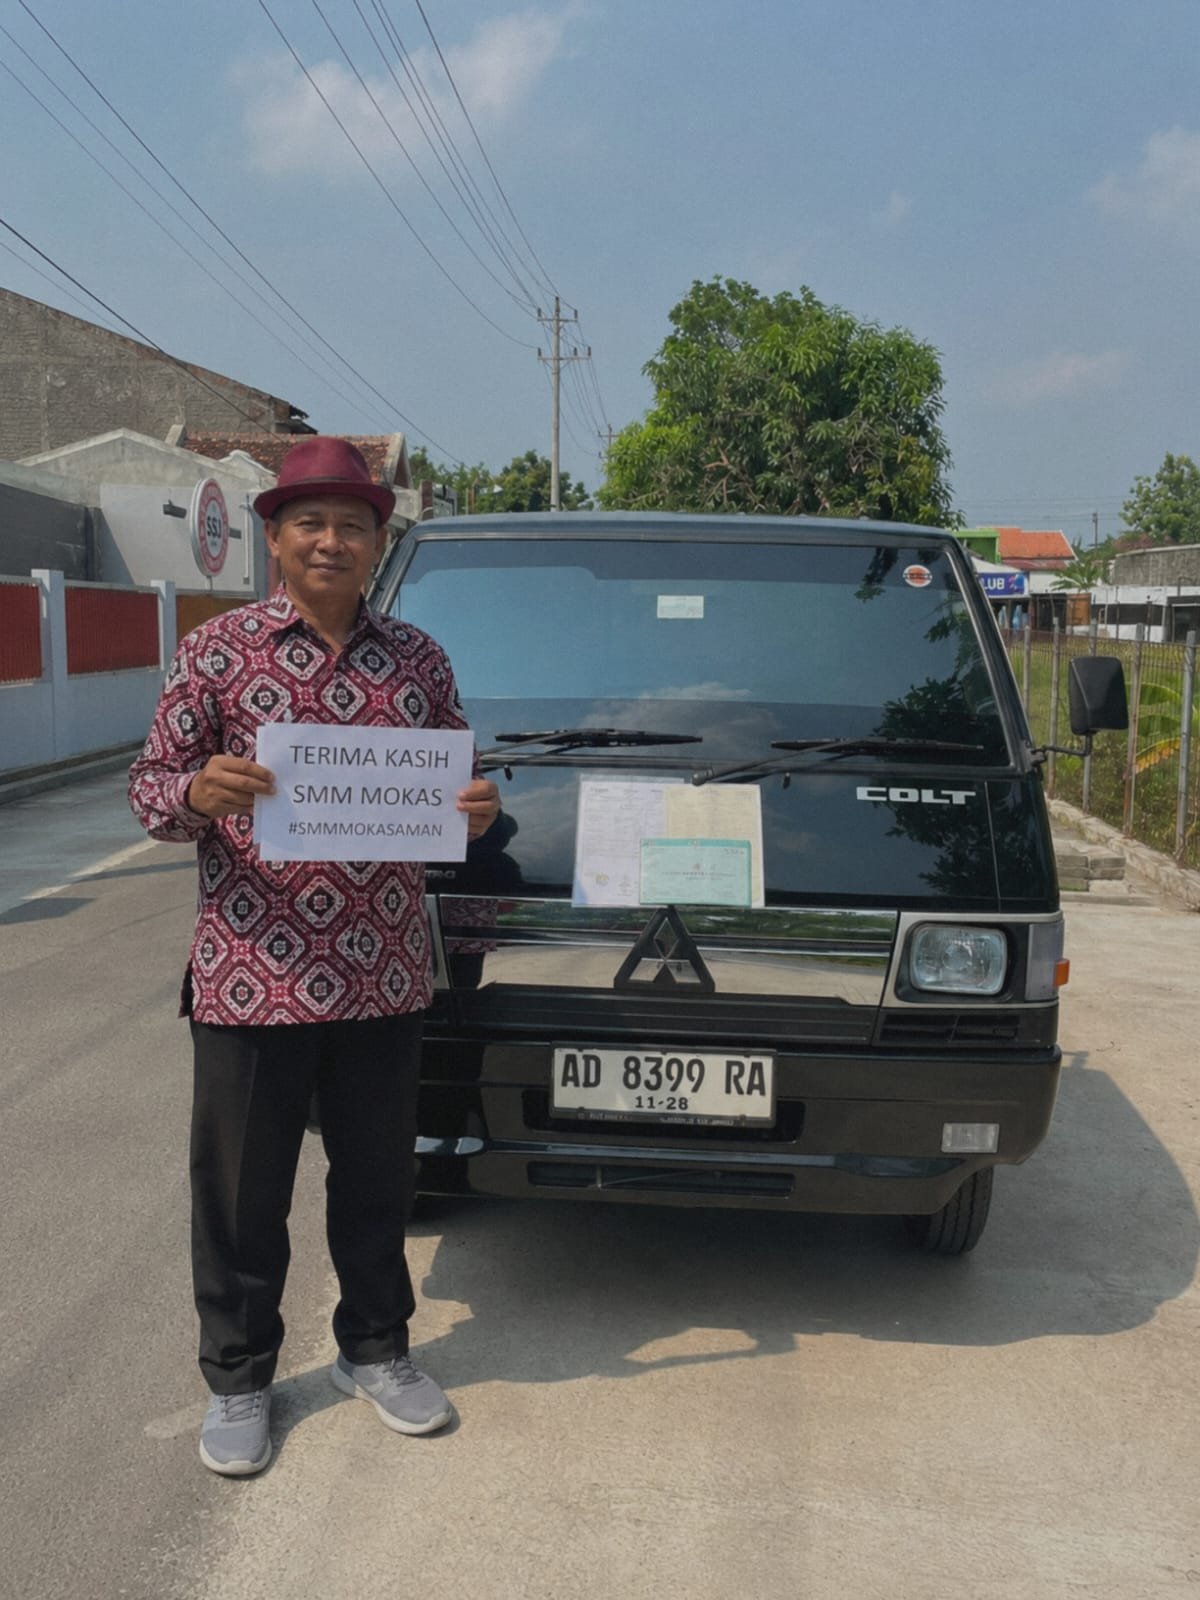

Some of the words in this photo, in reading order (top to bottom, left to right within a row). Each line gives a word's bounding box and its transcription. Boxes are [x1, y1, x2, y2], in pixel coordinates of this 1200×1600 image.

[289, 745, 377, 767] TERIMA
[386, 748, 449, 768] KASIH
[292, 784, 352, 805] SMM
[360, 786, 443, 807] MOKAS
[856, 786, 976, 804] COLT
[288, 821, 443, 837] #SMMMOKASAMAN
[561, 1053, 601, 1088] AD
[622, 1056, 705, 1093] 8399
[724, 1060, 766, 1096] RA
[635, 1096, 689, 1110] 11-28
